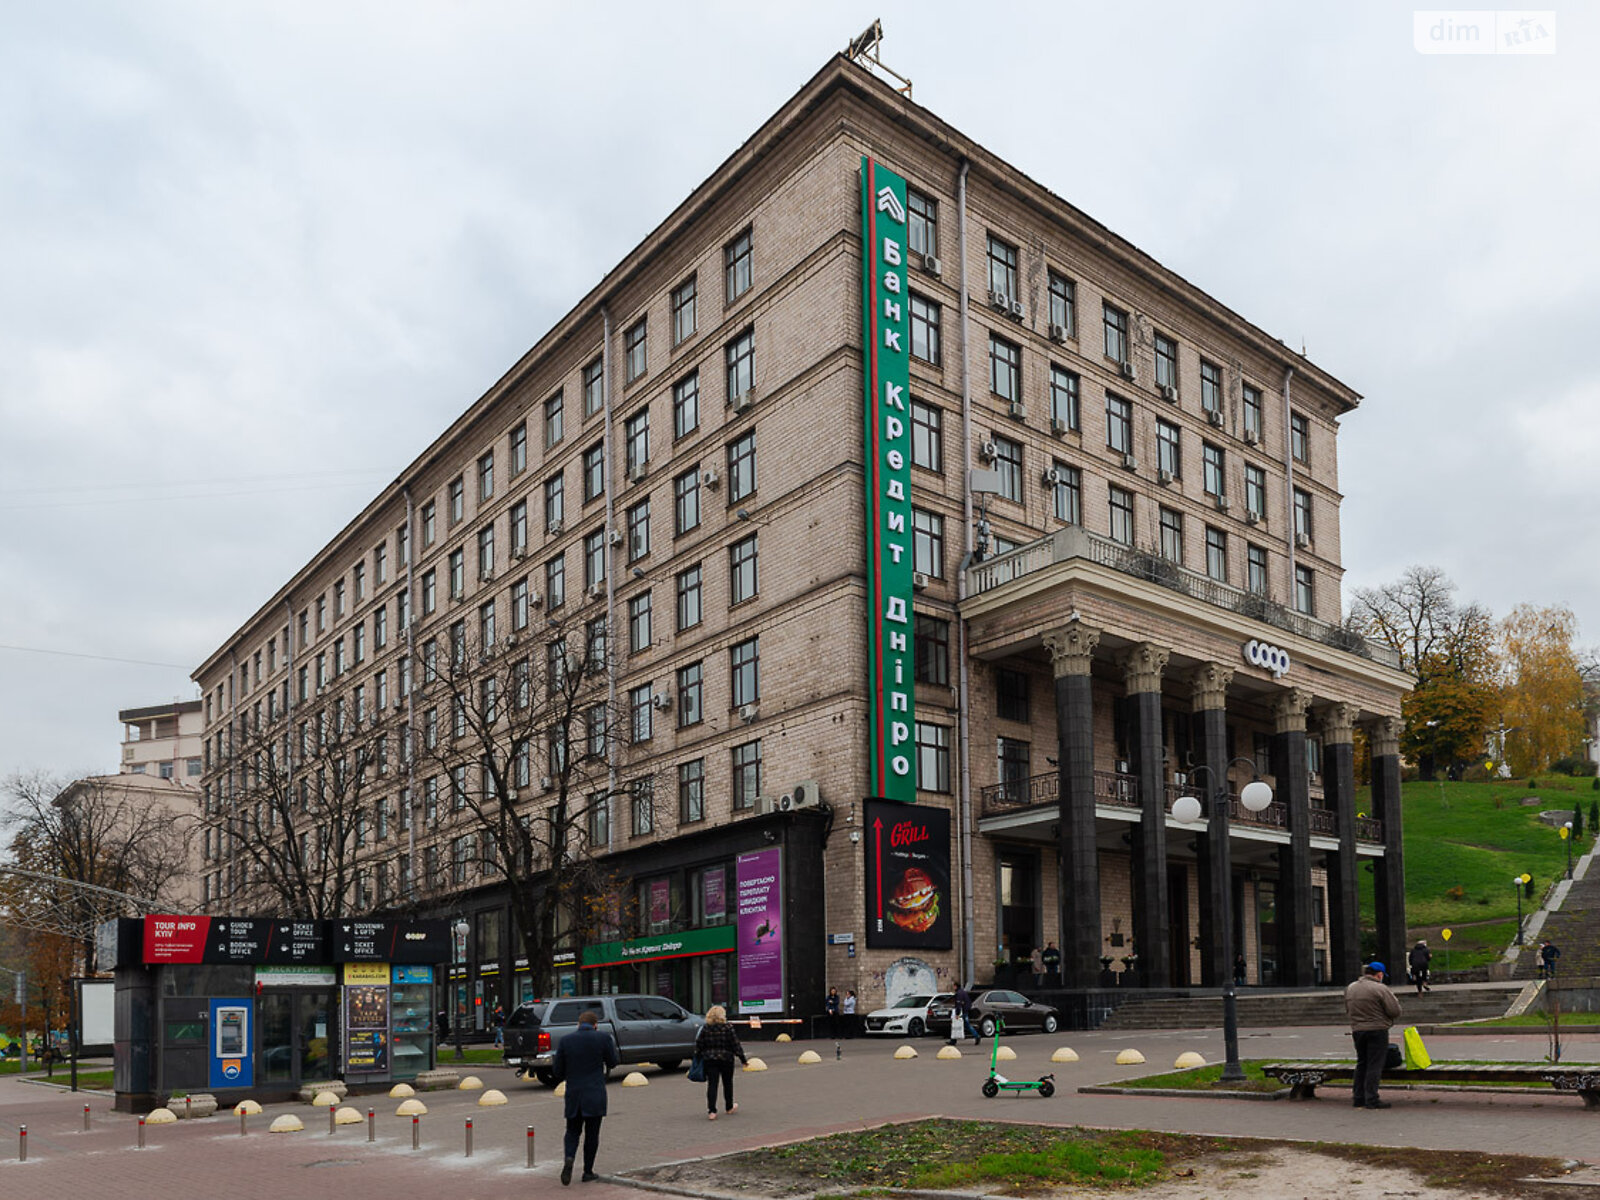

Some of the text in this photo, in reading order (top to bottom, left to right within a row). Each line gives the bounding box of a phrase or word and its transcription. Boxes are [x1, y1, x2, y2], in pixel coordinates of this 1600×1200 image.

[883, 237, 910, 776] Банк Кредит Дніпро
[739, 886, 770, 897] ПЕРЕПЛАТУ
[739, 896, 768, 906] ШВИДКИМ
[154, 922, 196, 931] TOUR INFO
[230, 921, 254, 929] GUIDED
[292, 923, 314, 931] TICKET
[154, 930, 173, 938] KYIV
[230, 941, 258, 949] BOOKING
